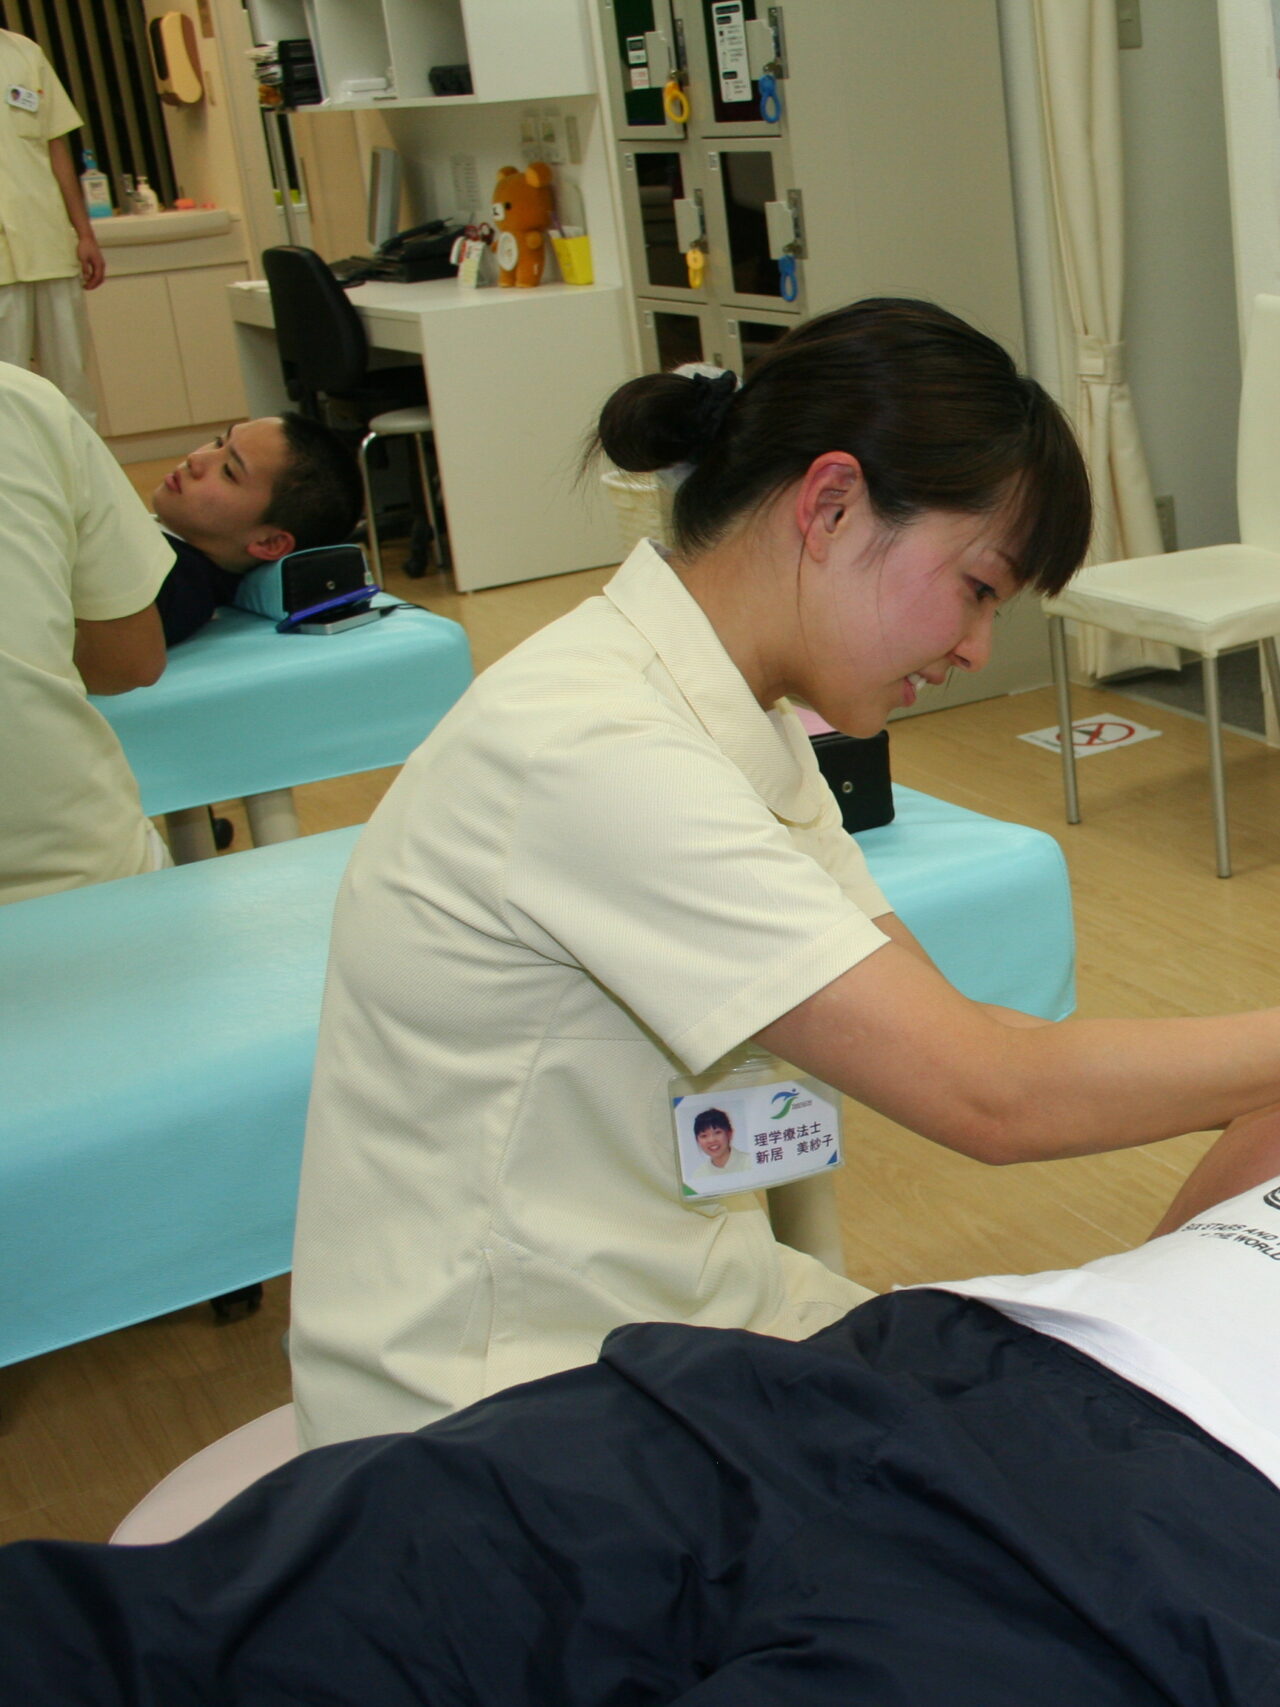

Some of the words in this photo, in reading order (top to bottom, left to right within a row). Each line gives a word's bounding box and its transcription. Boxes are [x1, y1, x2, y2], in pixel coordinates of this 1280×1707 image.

[754, 1121, 822, 1147] 理学療法士
[755, 1147, 784, 1165] 新居
[1243, 1228, 1278, 1241] AND
